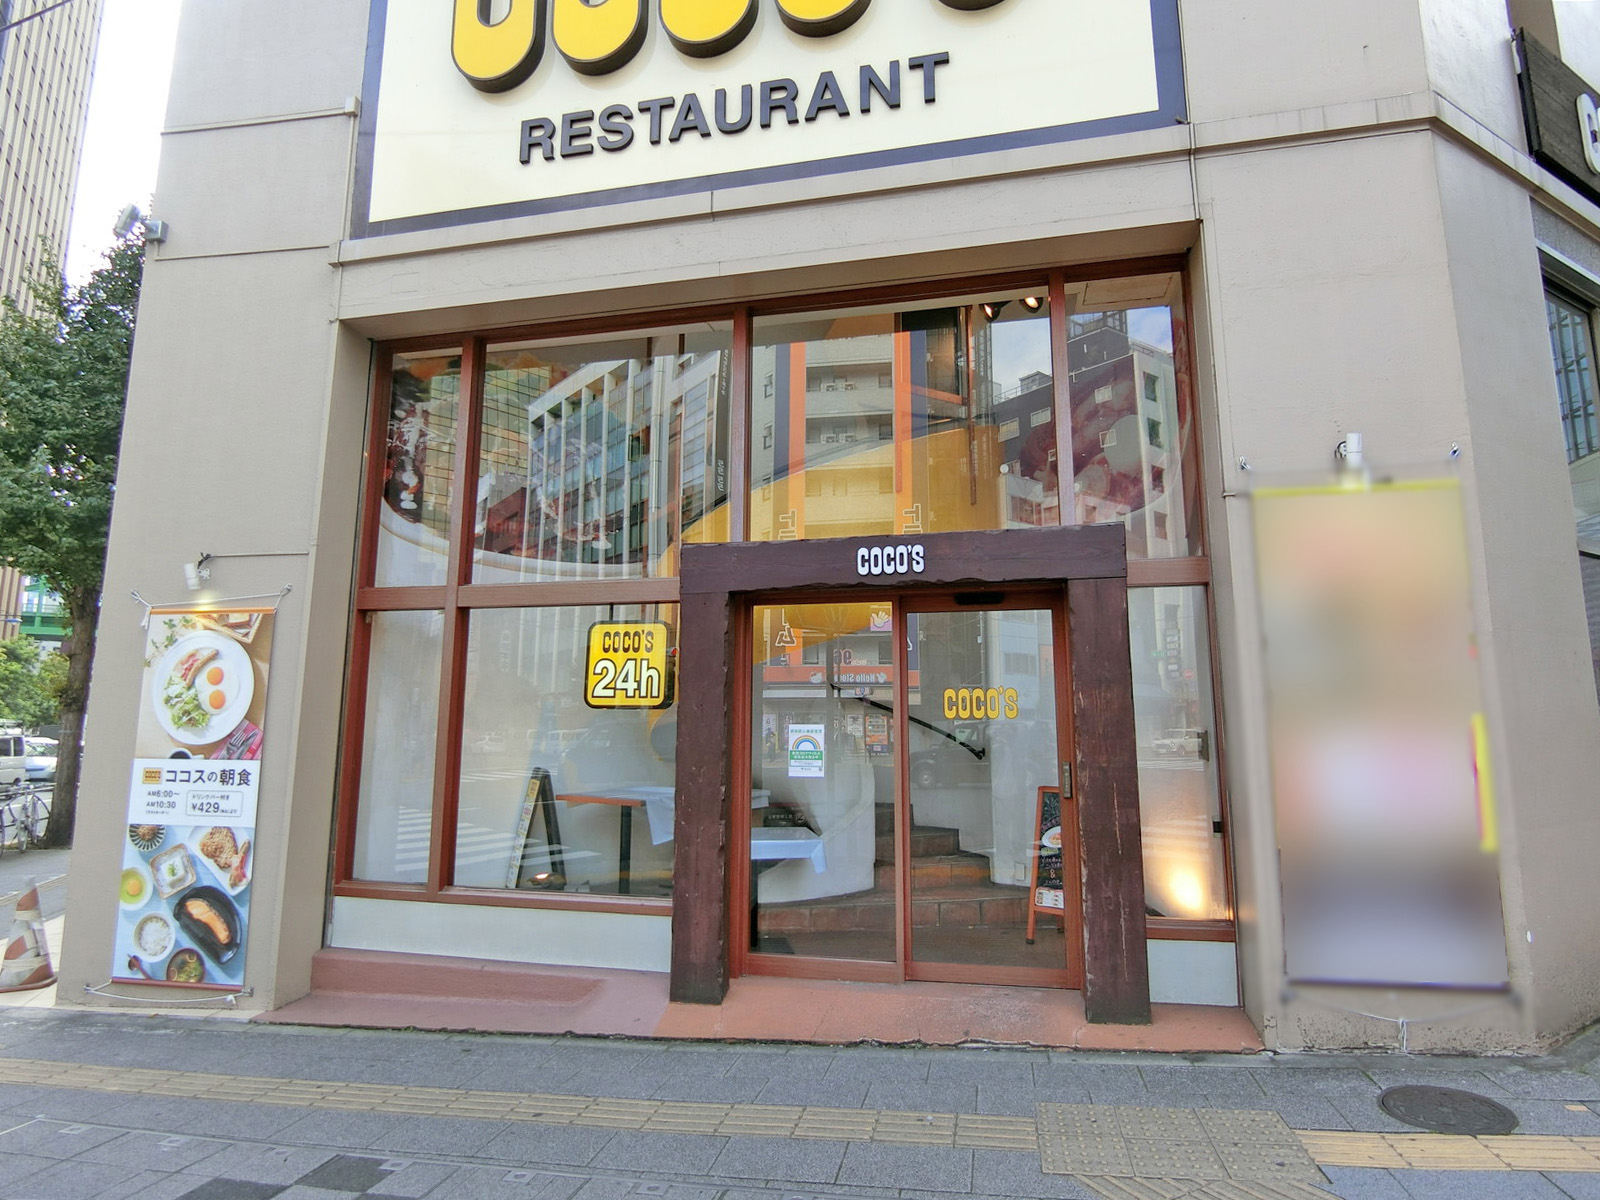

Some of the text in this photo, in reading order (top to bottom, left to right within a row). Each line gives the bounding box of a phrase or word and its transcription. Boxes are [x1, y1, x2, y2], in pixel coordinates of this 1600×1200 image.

[519, 51, 950, 165] RESTAURANT
[857, 544, 925, 576] COCO'S
[603, 628, 654, 653] COCO'S
[591, 658, 661, 698] 24h
[943, 685, 1018, 719] COCO'S
[165, 768, 252, 786] ココスの朝食
[146, 801, 177, 809] AM10:30
